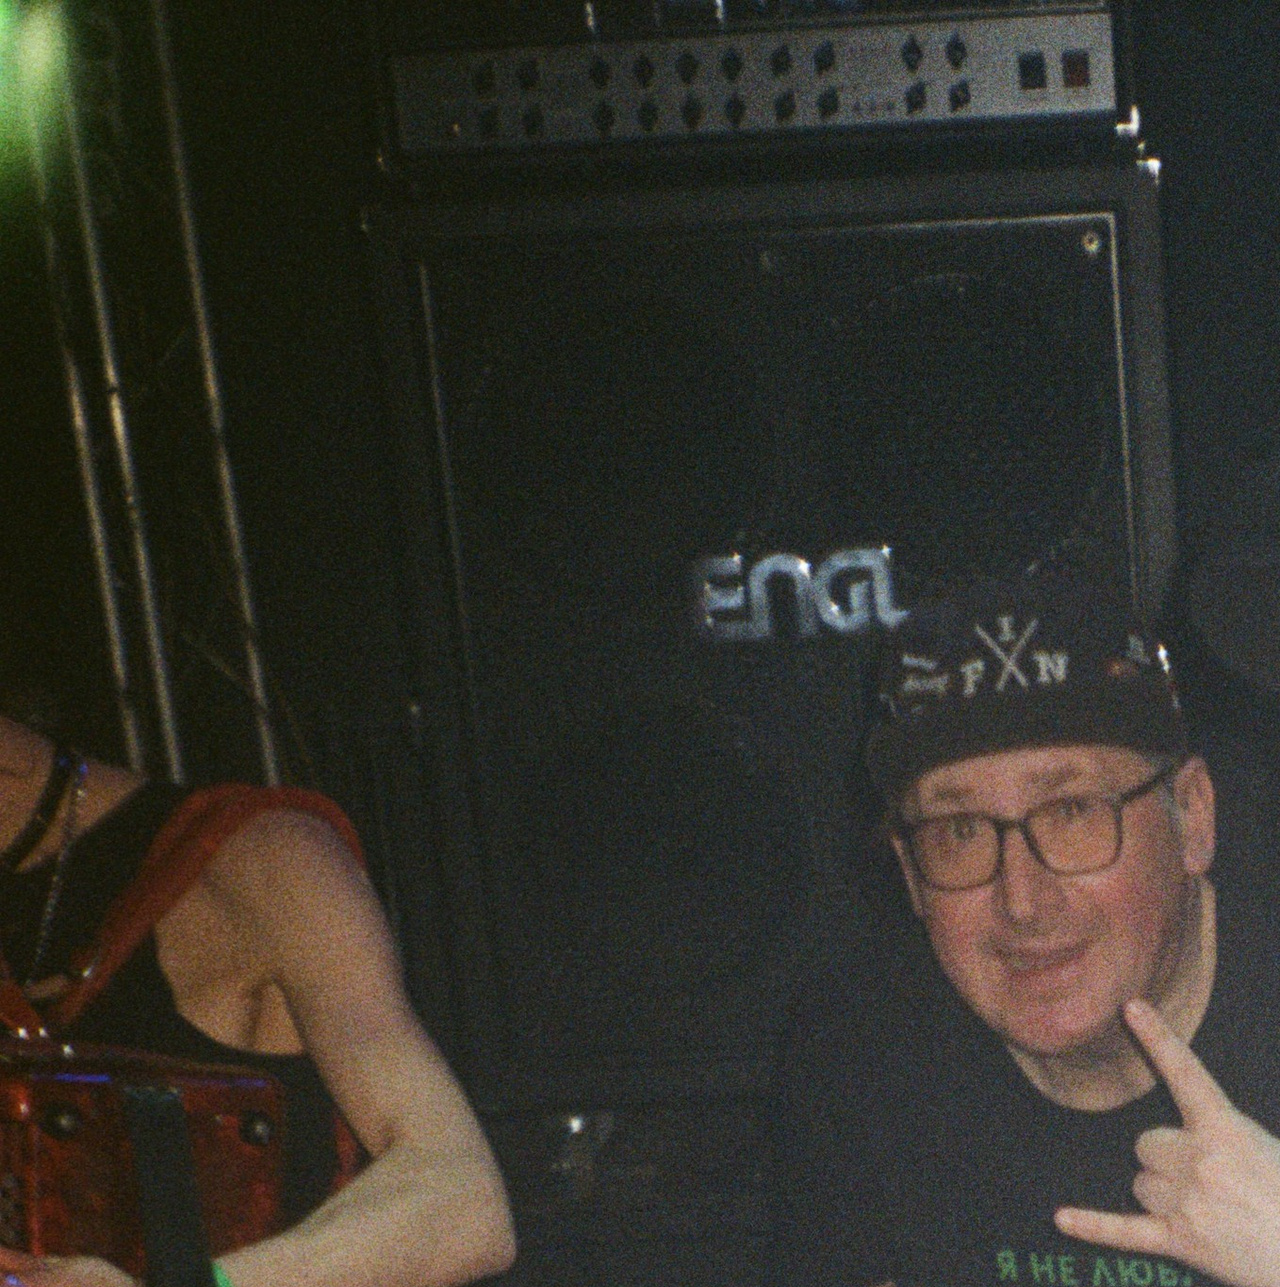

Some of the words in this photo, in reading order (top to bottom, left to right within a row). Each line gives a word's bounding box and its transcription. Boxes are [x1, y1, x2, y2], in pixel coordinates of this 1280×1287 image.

[996, 1249, 1019, 1282] Я
[1030, 1253, 1079, 1287] НЕ
[1092, 1256, 1194, 1287] ЛЮБ
